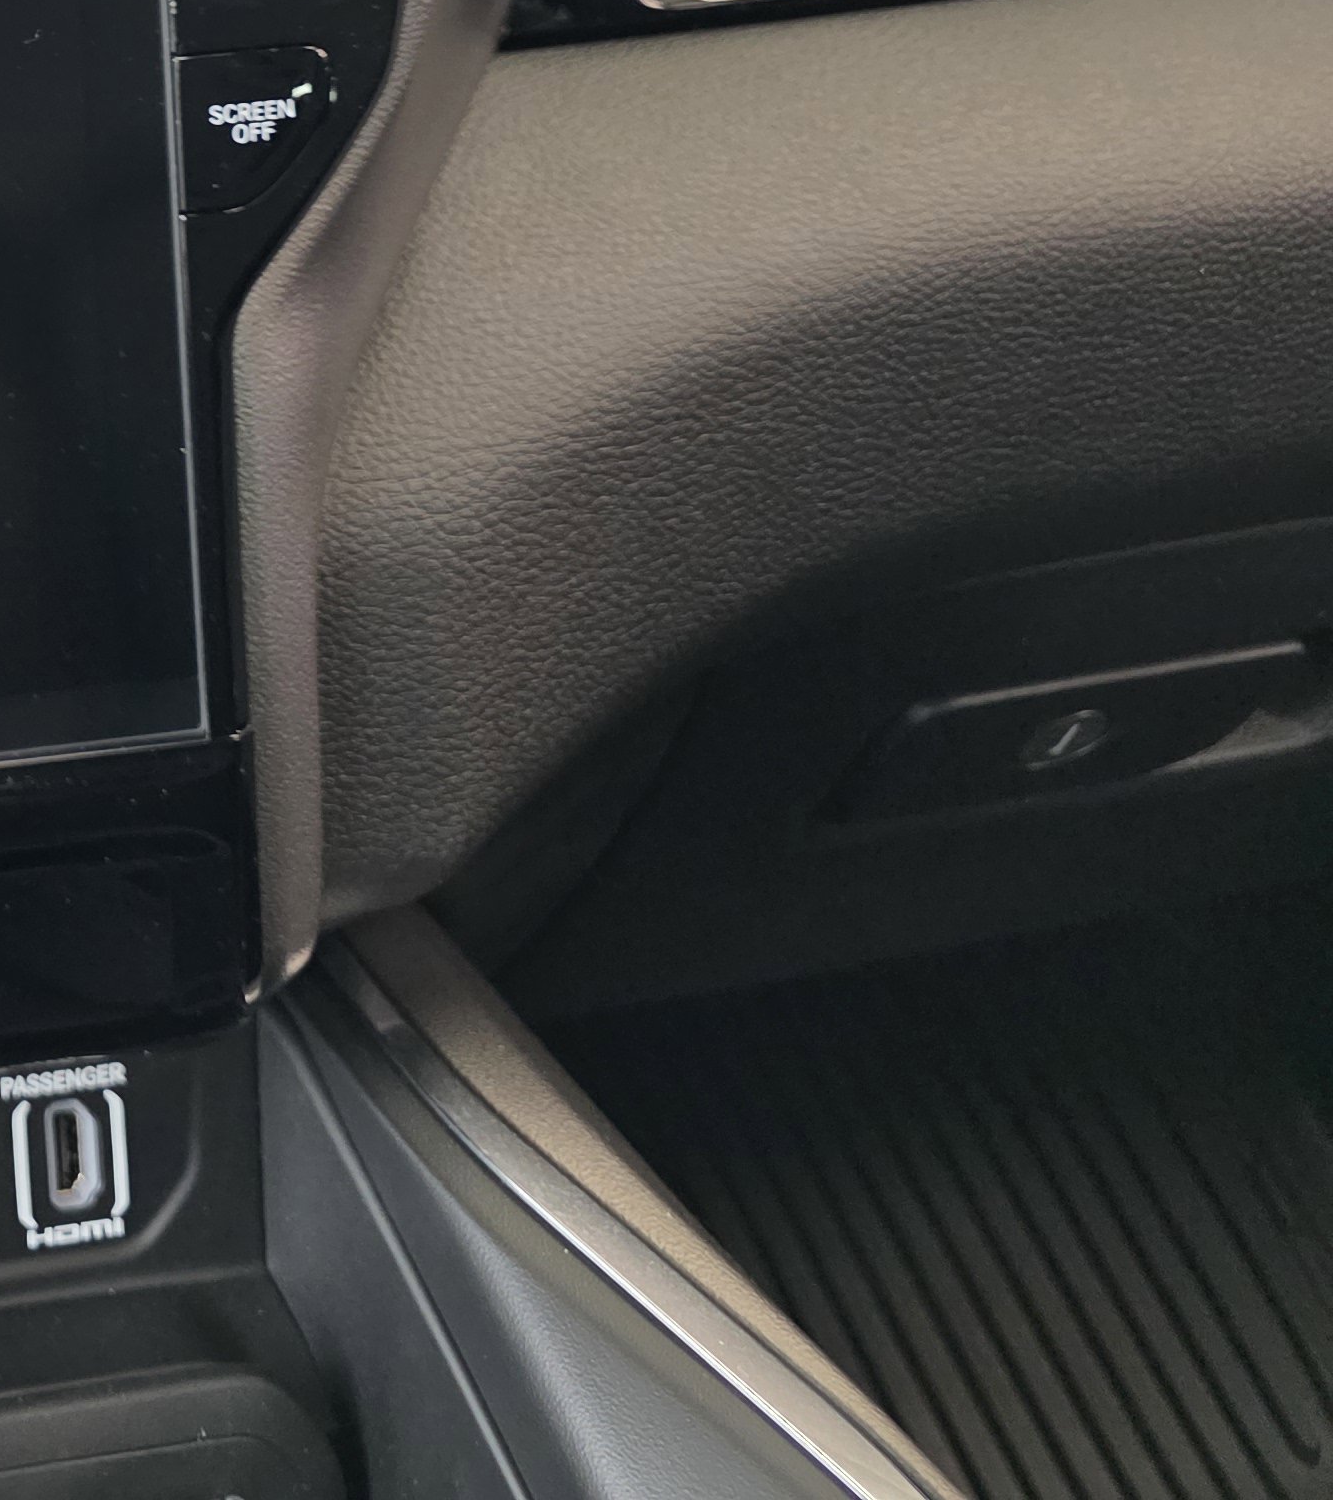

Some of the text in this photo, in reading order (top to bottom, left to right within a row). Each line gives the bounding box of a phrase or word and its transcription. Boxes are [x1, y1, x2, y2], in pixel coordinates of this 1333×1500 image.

[208, 98, 297, 126] SCREEN
[231, 121, 277, 144] OFF
[0, 1062, 127, 1099] PASSENGER
[26, 1216, 126, 1249] HDMI
